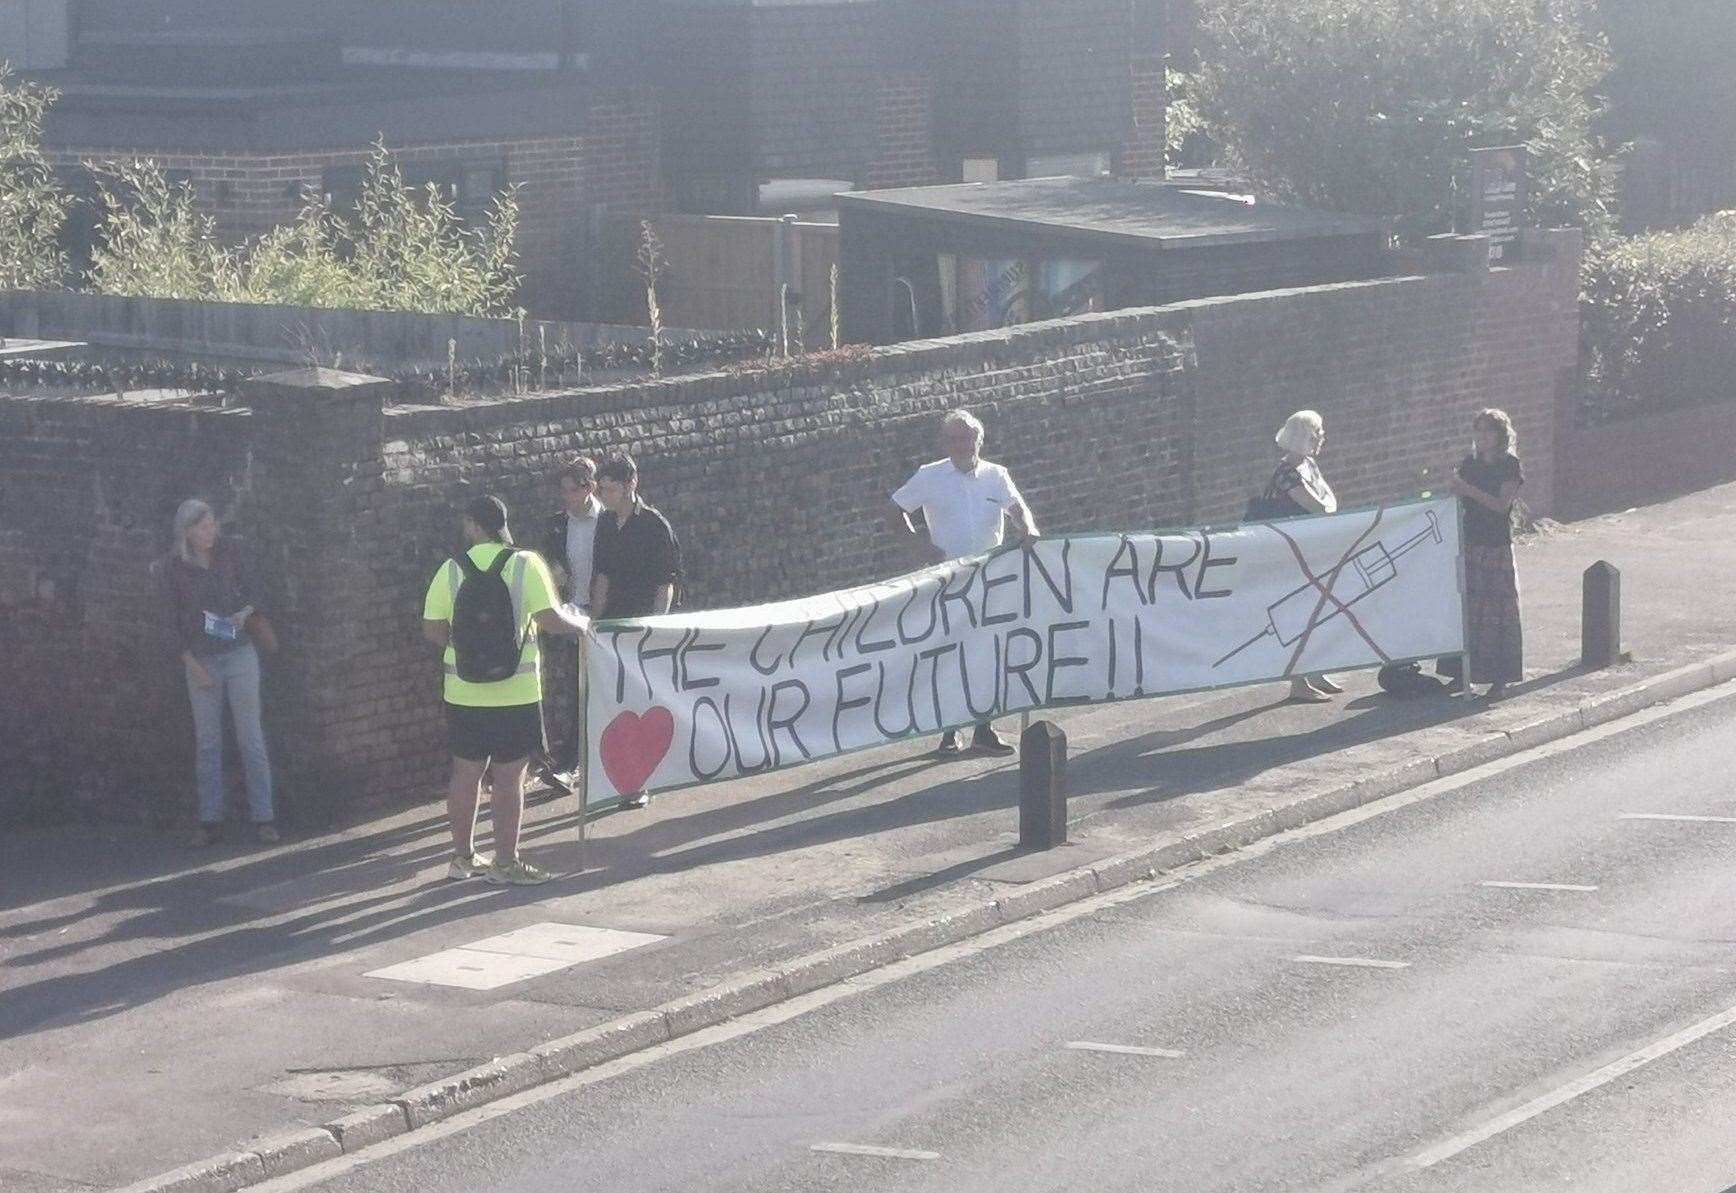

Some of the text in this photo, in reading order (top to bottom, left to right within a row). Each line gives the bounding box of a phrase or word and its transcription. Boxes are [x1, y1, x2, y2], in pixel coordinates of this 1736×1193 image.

[610, 533, 1238, 704] THE CHILDREN ARE
[688, 614, 1145, 779] OUR FUTURE!!
